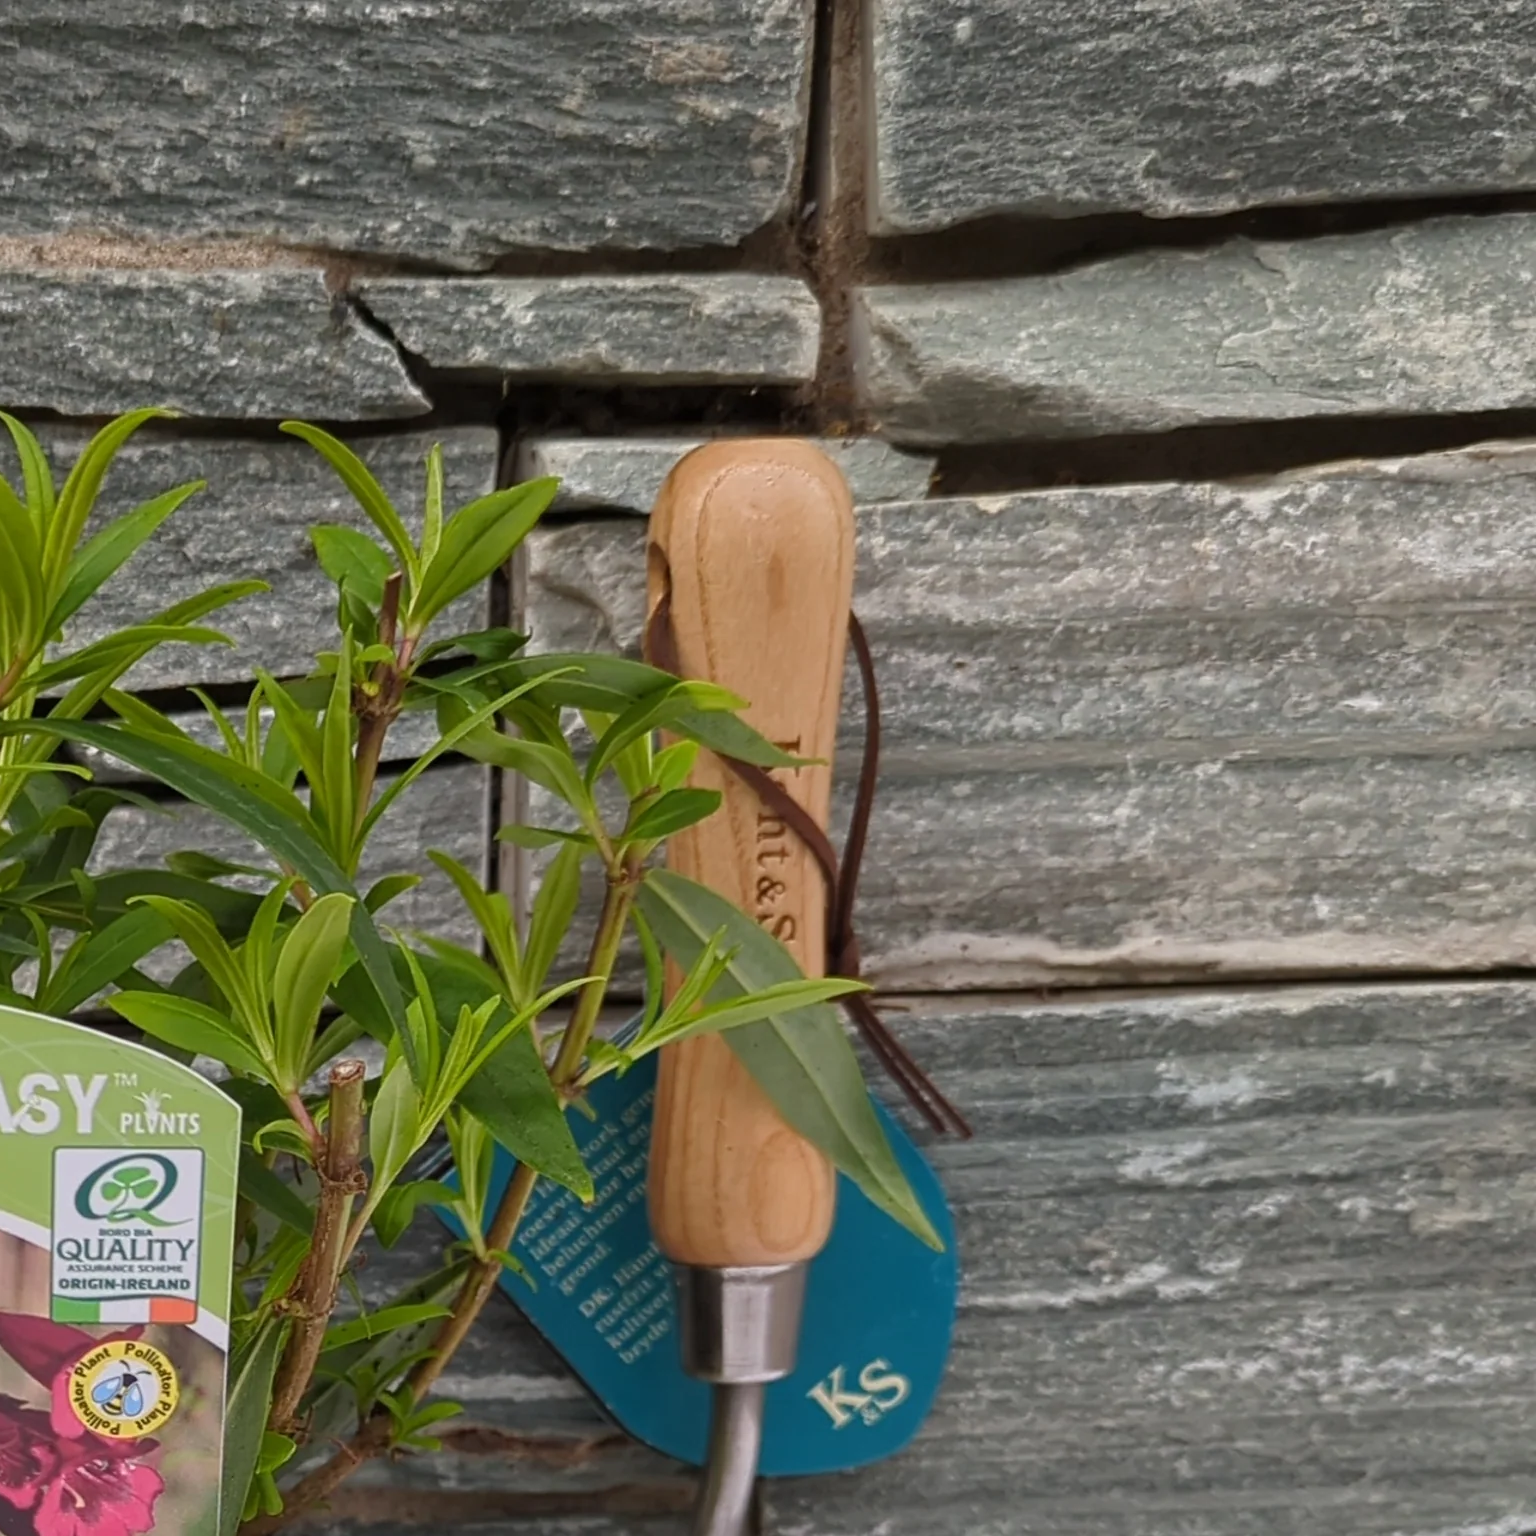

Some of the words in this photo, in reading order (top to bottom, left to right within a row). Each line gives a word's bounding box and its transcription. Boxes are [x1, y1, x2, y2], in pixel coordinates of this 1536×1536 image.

[756, 876, 787, 905] &
[98, 1228, 131, 1237] BORD
[133, 1228, 154, 1237] BIA
[56, 1238, 195, 1263] QUALITY
[67, 1264, 135, 1273] ASSURANCE
[137, 1265, 183, 1273] SCHEME
[58, 1278, 191, 1291] ORIGIN-IRELAND
[74, 1347, 112, 1378] Plant
[124, 1343, 173, 1398] Pollinator
[73, 1381, 122, 1436] Pollinator
[135, 1400, 172, 1430] Plant
